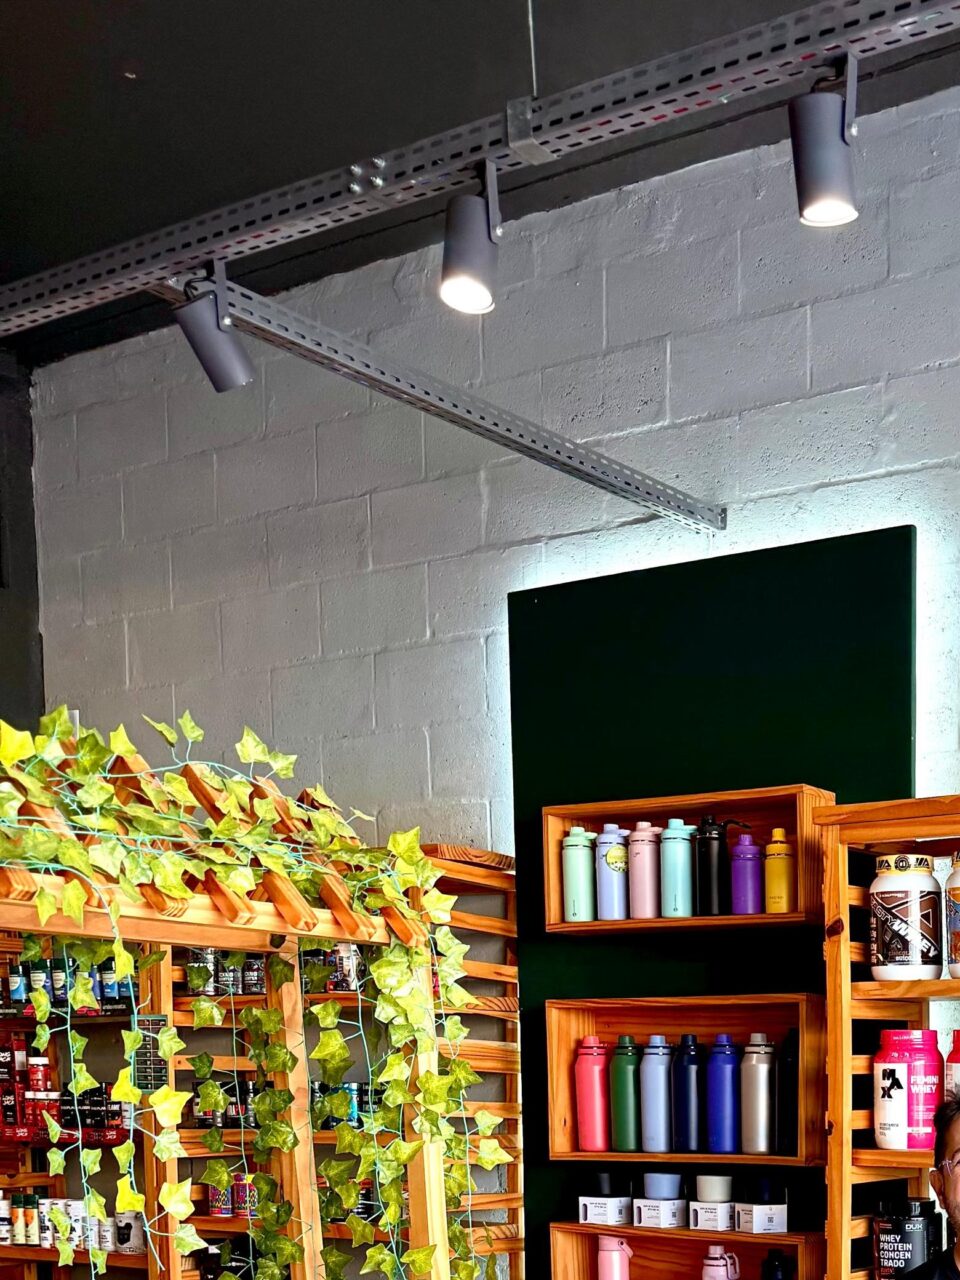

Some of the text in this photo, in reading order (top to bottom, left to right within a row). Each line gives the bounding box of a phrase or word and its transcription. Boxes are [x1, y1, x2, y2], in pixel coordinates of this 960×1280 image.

[911, 1085, 937, 1093] WHEY
[880, 1234, 901, 1242] WHEY
[880, 1242, 912, 1251] PROTEIN
[880, 1251, 911, 1259] CONCEN
[880, 1259, 905, 1267] TRADO
